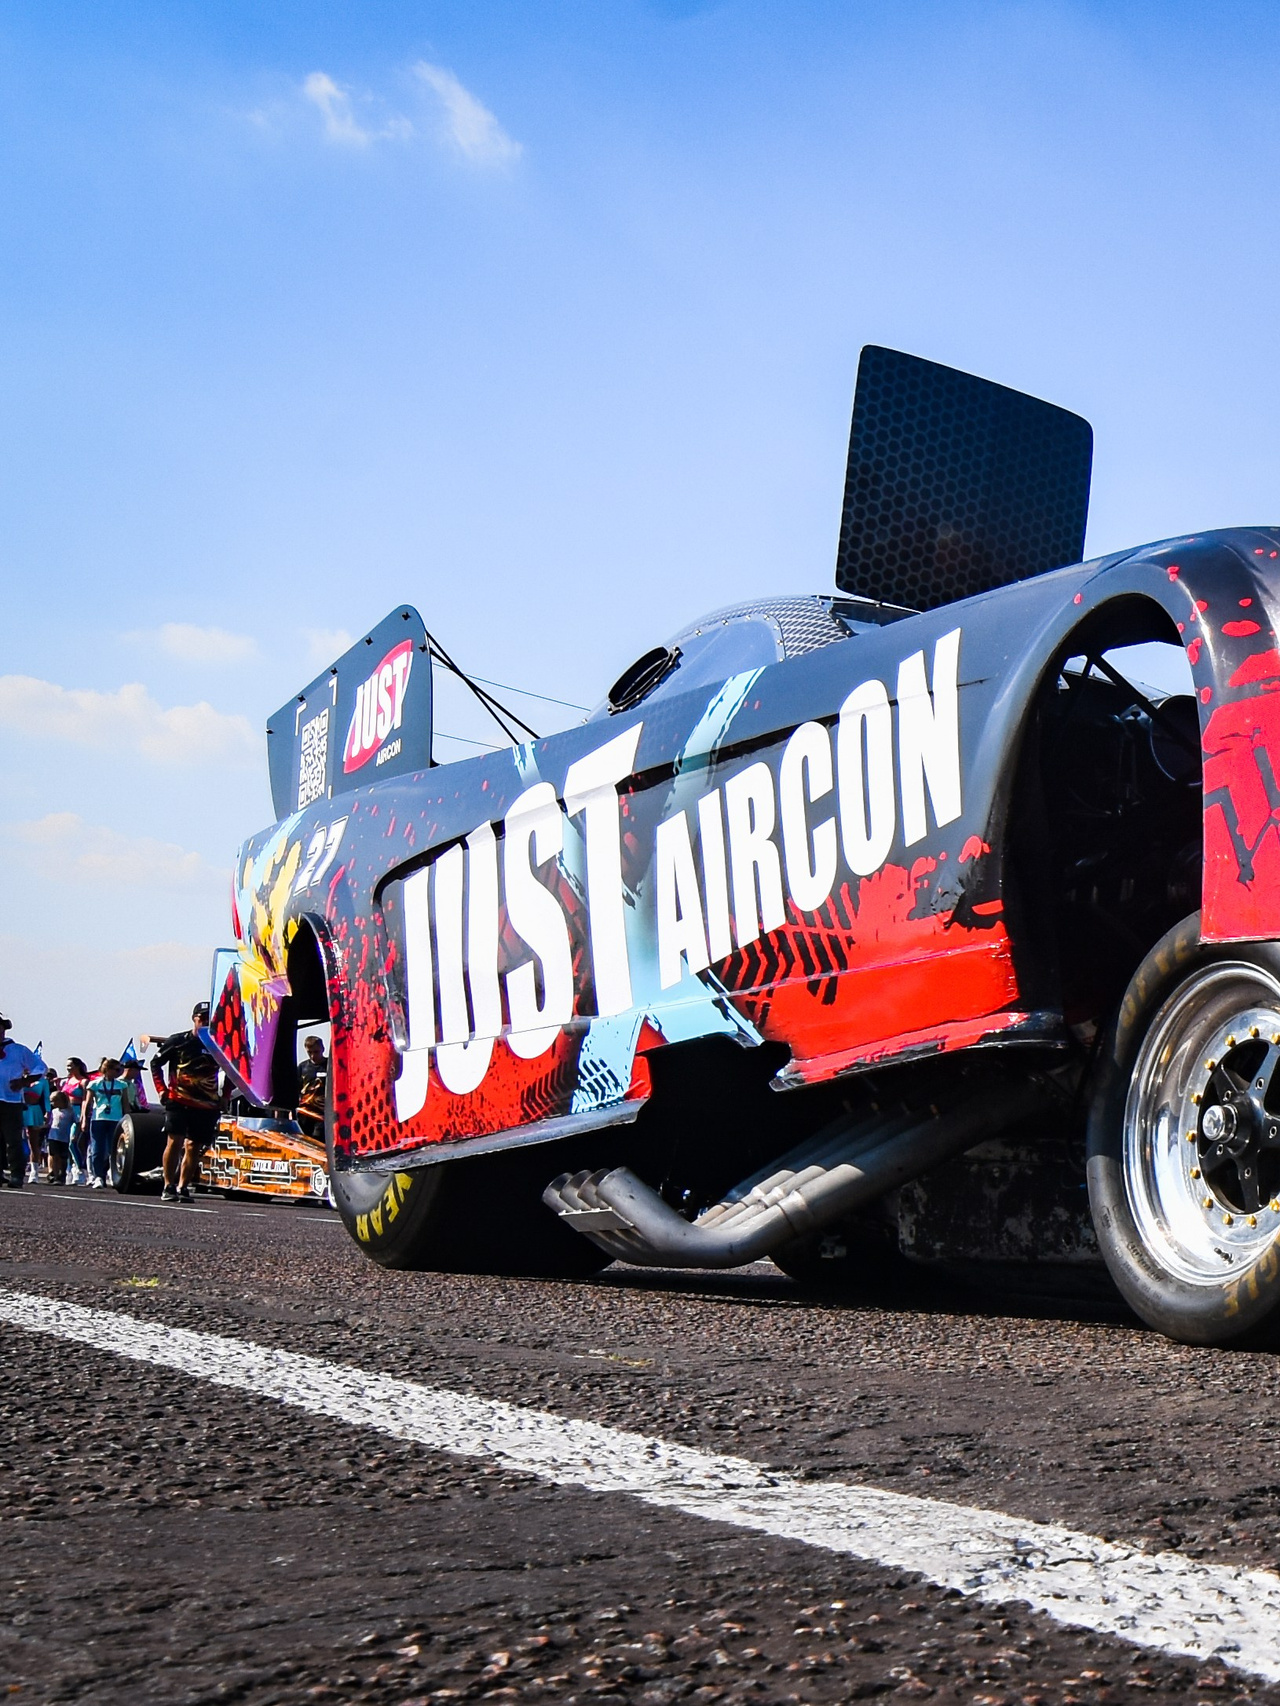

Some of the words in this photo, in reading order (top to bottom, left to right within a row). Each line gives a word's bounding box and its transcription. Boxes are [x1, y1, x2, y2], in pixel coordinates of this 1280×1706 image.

[351, 652, 408, 758] JUST
[376, 738, 402, 767] AIRCON
[293, 815, 350, 897] 27
[395, 721, 644, 1124] JUST
[655, 626, 962, 991] AIRCON
